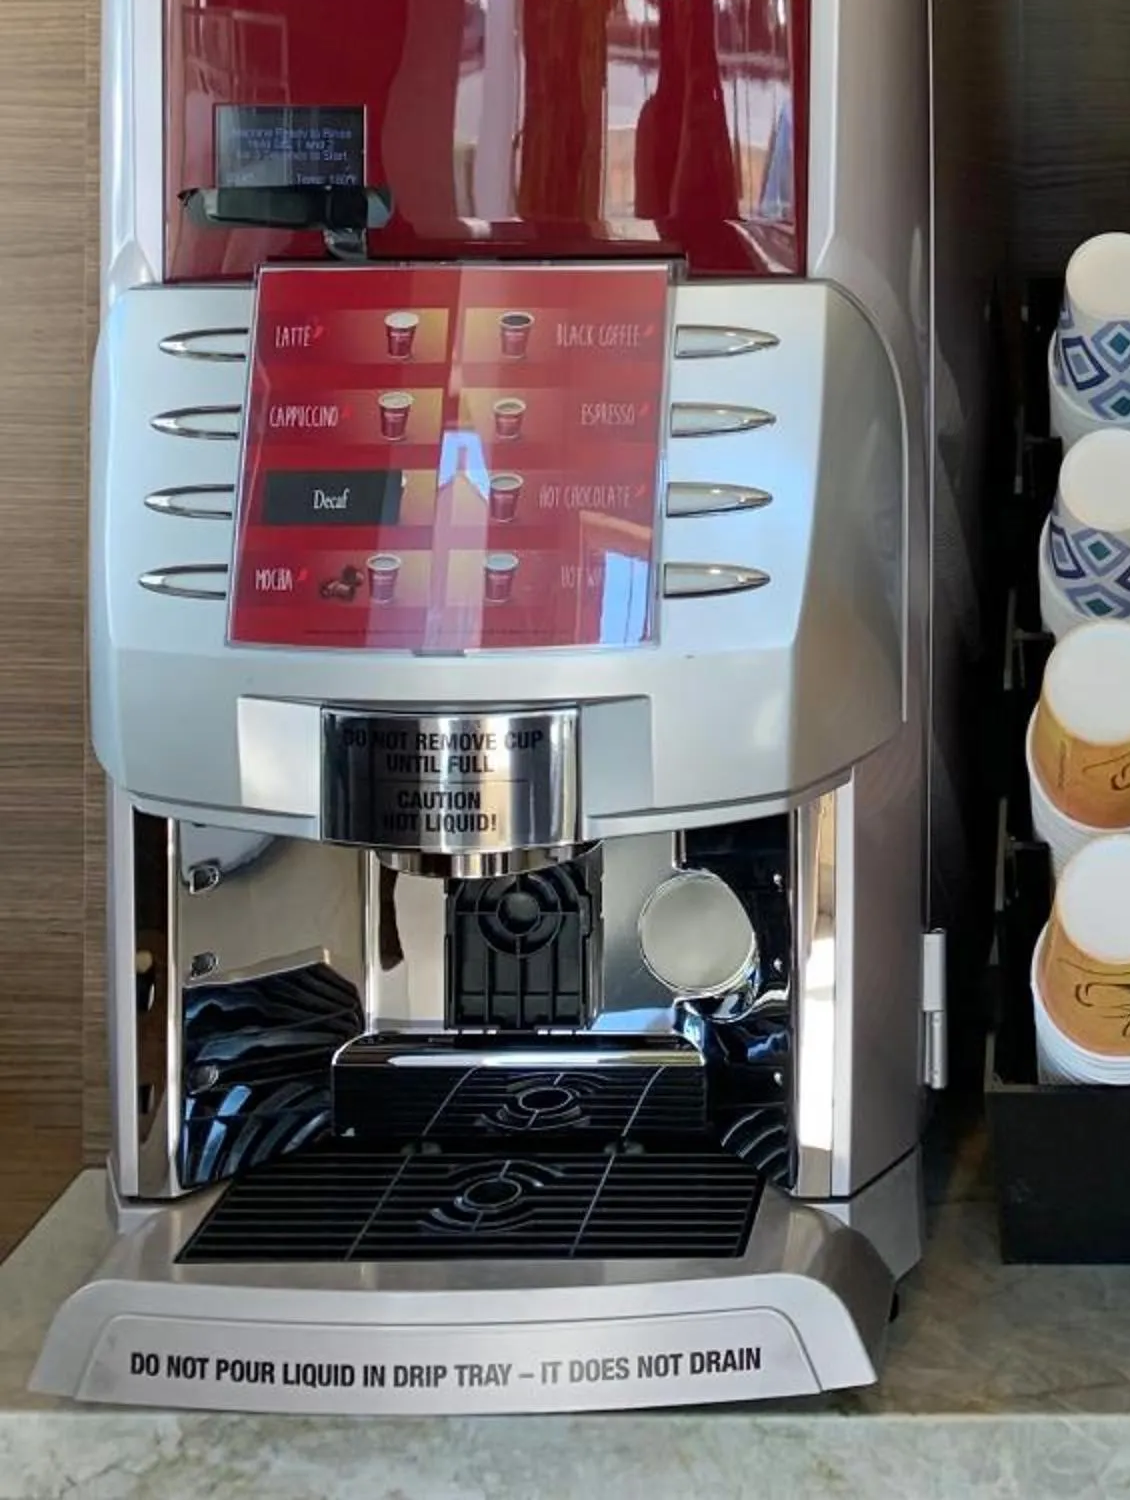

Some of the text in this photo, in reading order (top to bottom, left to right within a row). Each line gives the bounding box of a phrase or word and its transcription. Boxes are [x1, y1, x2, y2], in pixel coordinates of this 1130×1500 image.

[275, 325, 311, 348] LATTE
[557, 324, 641, 348] BLACK COFFEE
[269, 405, 339, 428] CAPPUCCINO
[581, 403, 635, 426] ESPRESSO
[313, 489, 349, 509] Decaf
[539, 484, 630, 508] HOT CHOCOLATE
[255, 569, 293, 591] MOCHA
[342, 730, 544, 750] DO NOT REMOVE CUP
[386, 756, 494, 773] UNTIL FULL
[399, 792, 481, 809] CAUTION
[384, 814, 497, 832] HOT LIQUID!
[130, 1352, 160, 1377] DO
[166, 1355, 209, 1382] NOT
[215, 1360, 276, 1385] POUR
[282, 1362, 356, 1390] LIQUID
[363, 1363, 385, 1388] IN
[393, 1363, 447, 1388] DRIP
[454, 1363, 512, 1387] TRAY
[541, 1362, 563, 1385] IT
[569, 1357, 631, 1383] DOES
[636, 1352, 683, 1379] NOT
[689, 1346, 762, 1375] DRAIN
